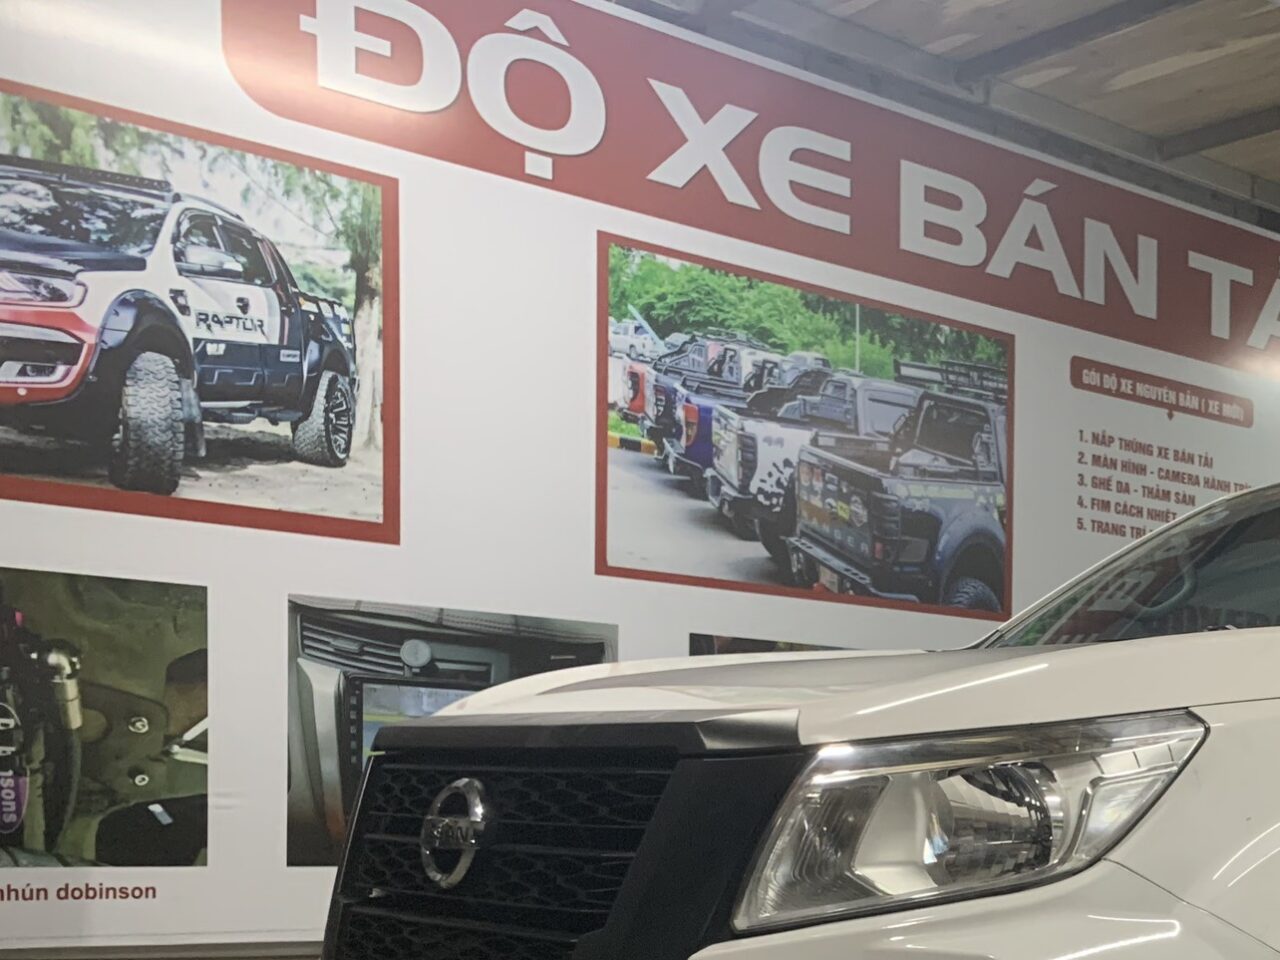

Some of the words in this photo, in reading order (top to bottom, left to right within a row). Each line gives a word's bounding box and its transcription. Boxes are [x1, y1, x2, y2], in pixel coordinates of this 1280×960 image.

[300, 0, 606, 180] ĐỘ
[646, 77, 852, 236] XE
[899, 163, 1158, 321] BÁN
[195, 312, 270, 341] RAPTOR
[1082, 368, 1100, 387] GÓI
[1103, 373, 1117, 394] ĐỘ
[1120, 379, 1133, 394] XE
[1207, 401, 1220, 415] XE
[1079, 429, 1088, 443] 1.
[1157, 446, 1169, 460] XE
[1197, 451, 1213, 468] TẢI
[1078, 451, 1087, 466] 2.
[1157, 467, 1200, 487] CAMERA
[1077, 473, 1087, 488] 3.
[1091, 474, 1113, 491] GHẾ
[1116, 481, 1130, 495] DA
[1077, 495, 1087, 510] 4.
[1091, 497, 1111, 513] FIM
[1114, 500, 1144, 518] CÁCH
[1077, 517, 1086, 531] 5.
[1091, 519, 1126, 538] TRANG
[56, 883, 157, 900] dobinson
